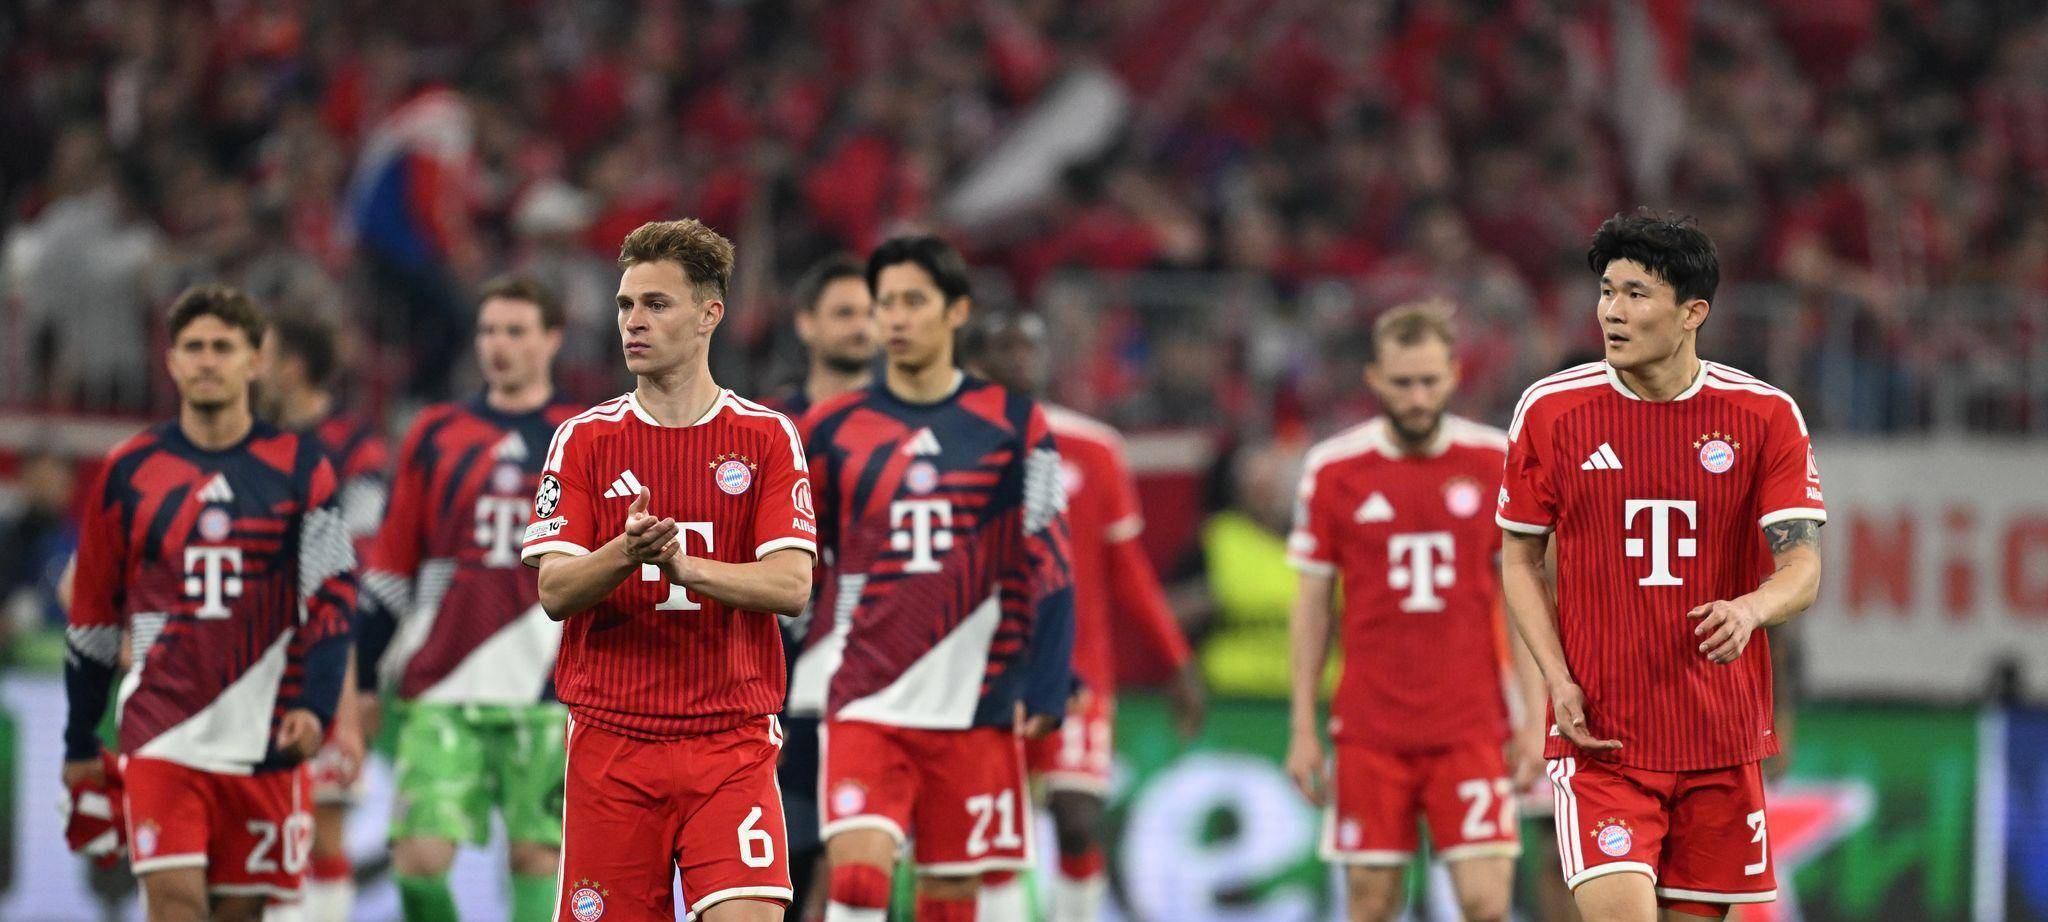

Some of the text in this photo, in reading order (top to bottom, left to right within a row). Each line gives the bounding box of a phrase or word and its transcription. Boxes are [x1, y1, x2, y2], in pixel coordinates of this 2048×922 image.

[474, 496, 529, 568] T
[792, 517, 817, 535] Allia
[890, 500, 953, 573] T
[1625, 499, 1697, 586] T
[183, 546, 243, 619] T
[1387, 532, 1456, 612] T
[736, 806, 775, 868] 6
[966, 788, 1021, 856] 21
[1745, 808, 1768, 876] 3
